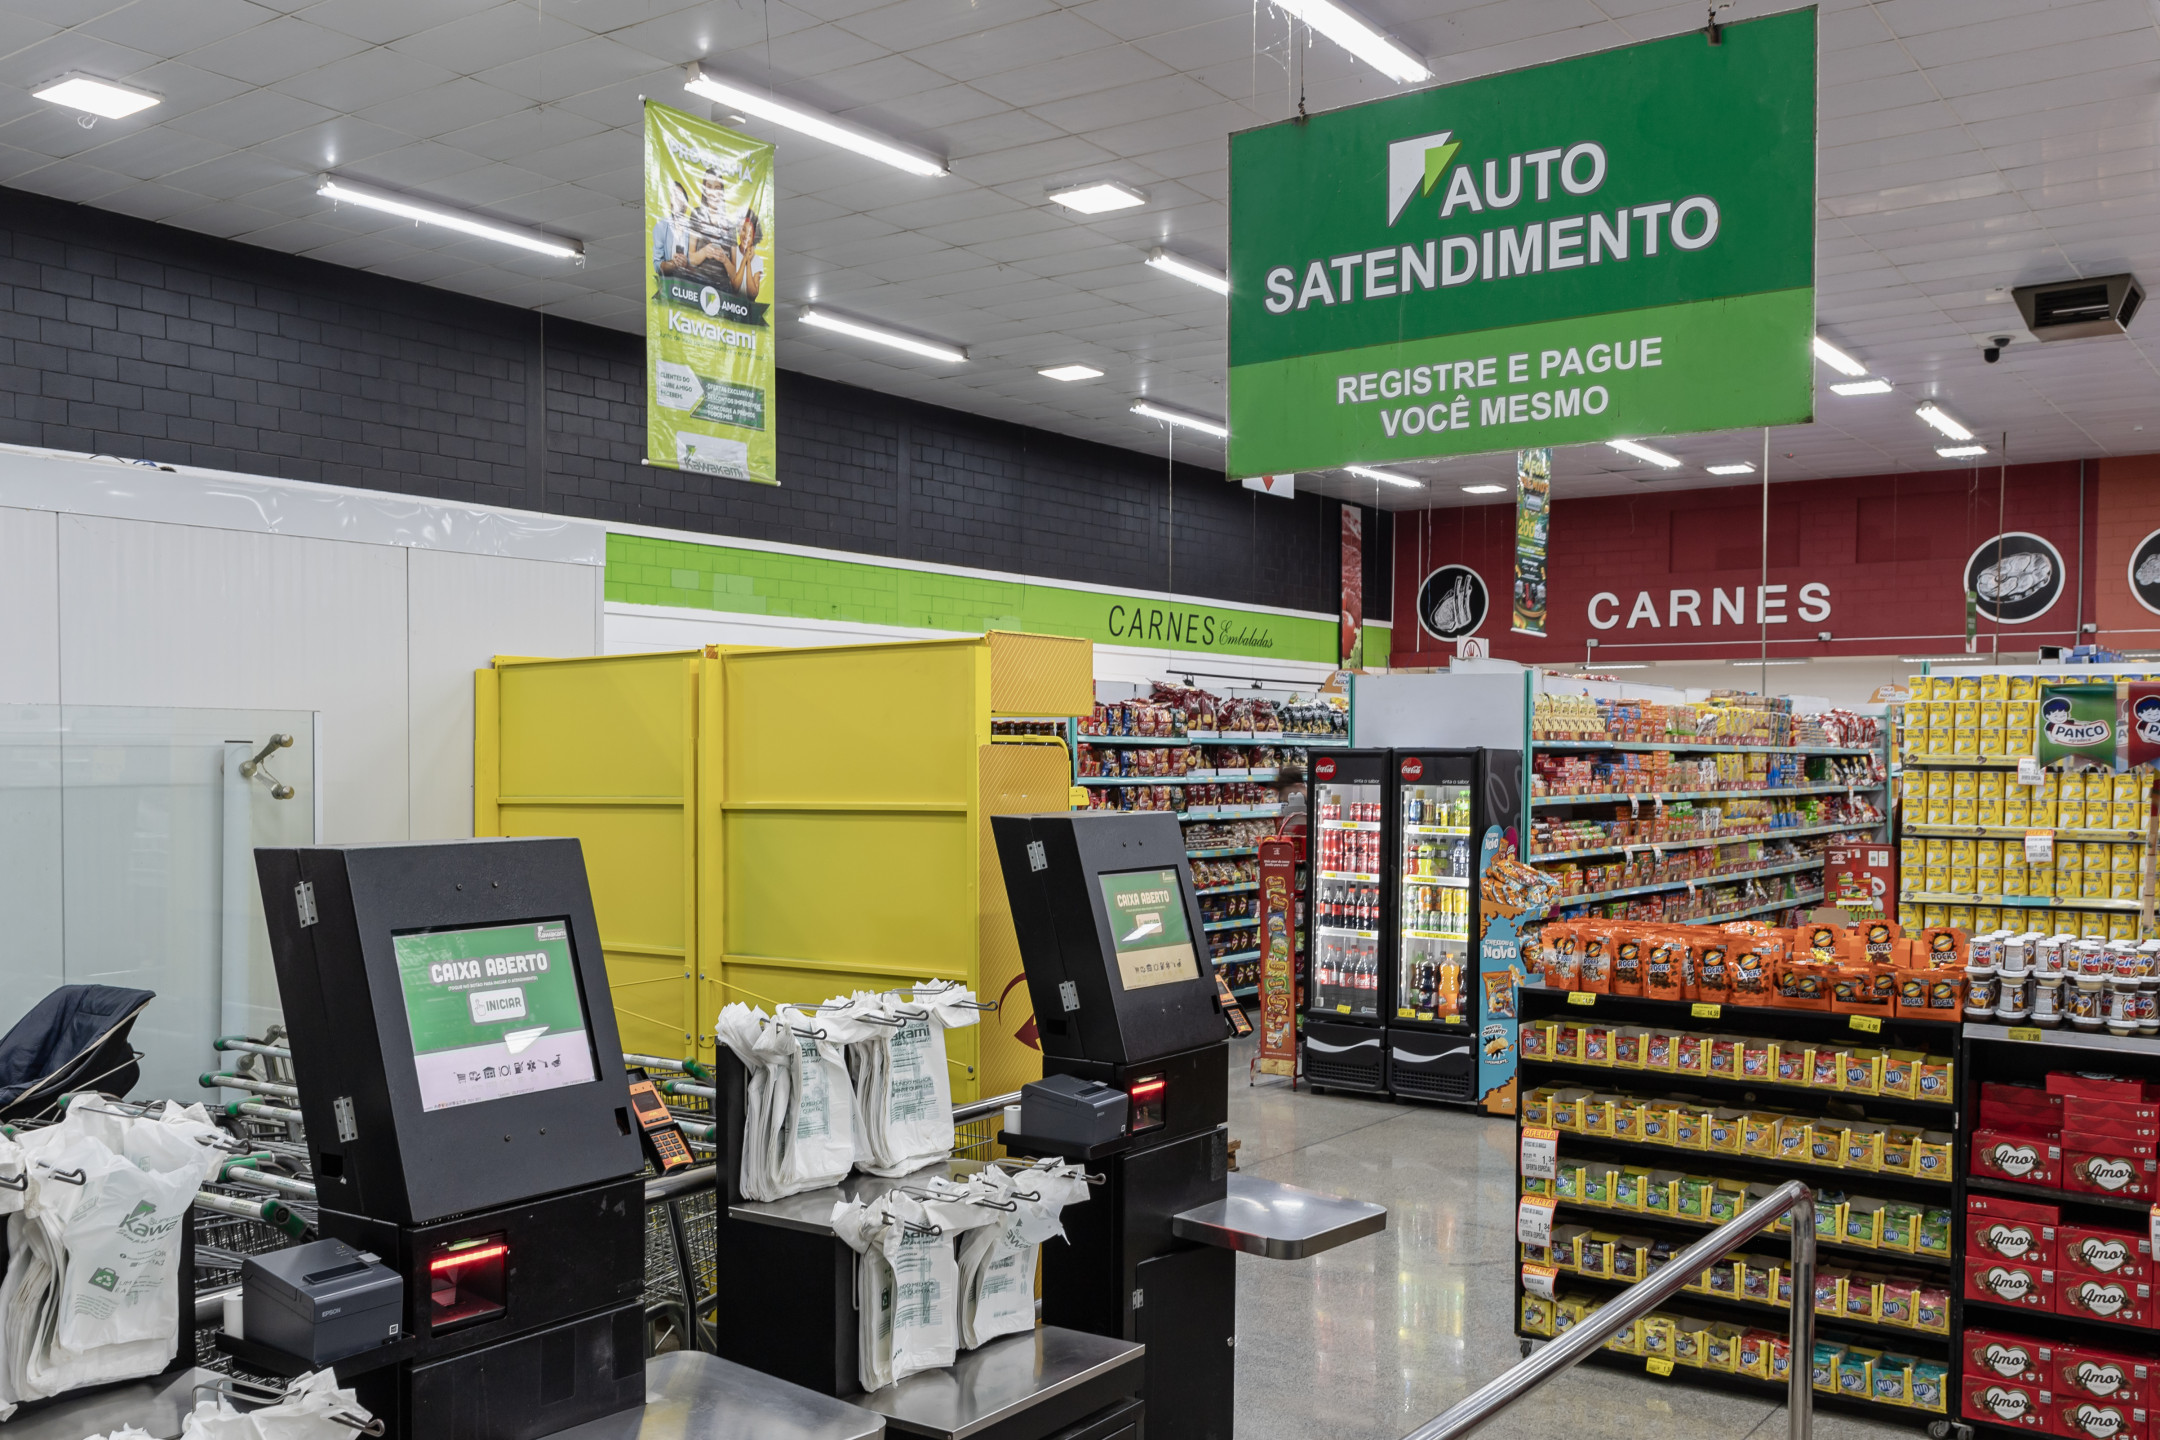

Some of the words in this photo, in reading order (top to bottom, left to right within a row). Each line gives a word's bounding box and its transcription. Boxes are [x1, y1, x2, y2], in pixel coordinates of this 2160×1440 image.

[1440, 142, 1607, 218] AUTO
[1264, 197, 1719, 313] SATENDIMENTO
[672, 286, 698, 302] CLUBE
[722, 301, 748, 316] AMIGO
[668, 309, 756, 350] Kawakami
[1338, 357, 1497, 403] REGISTRE
[1509, 354, 1529, 383] E
[1541, 337, 1662, 378] PAGUE
[1381, 395, 1471, 437] VOCÊ
[1481, 386, 1609, 427] MESMO
[1518, 518, 1536, 537] 200
[1587, 582, 1831, 630] CARNES
[1109, 605, 1215, 645] CARNES
[1219, 620, 1274, 648] Embaladas
[2055, 725, 2104, 738] PANCO
[1117, 893, 1140, 907] CAIXA
[1140, 890, 1170, 904] ABERTO
[1482, 945, 1517, 960] NOVO
[1866, 943, 1892, 953] ROCKS
[1617, 960, 1639, 968] ROCKS
[1930, 951, 1957, 962] ROCKS
[431, 960, 481, 983] CAIXA
[485, 952, 548, 976] ABERTO
[486, 997, 521, 1011] INICIAR
[1848, 1070, 1864, 1080] MID
[1885, 1072, 1901, 1082] MID
[1921, 1078, 1937, 1088] MID
[1524, 1129, 1556, 1140] OFERTA
[1646, 1124, 1660, 1133] MID
[1712, 1130, 1726, 1140] MID
[1921, 1156, 1937, 1166] MID
[1993, 1149, 2040, 1166] Amor
[2087, 1163, 2133, 1179] Amor
[1522, 1196, 1554, 1208] OFERTA
[1987, 1231, 2033, 1246] Amor
[2081, 1244, 2127, 1260] Amor
[1986, 1273, 2032, 1289] Amor
[2080, 1288, 2126, 1304] Amor
[321, 1306, 341, 1318] EPSON
[1884, 1302, 1899, 1313] MID
[1920, 1310, 1934, 1320] MID
[1742, 1351, 1757, 1362] MID
[1985, 1350, 2030, 1366] Amor
[2077, 1368, 2124, 1385] Amor
[1877, 1380, 1892, 1390] MID
[1913, 1384, 1929, 1395] MID
[1985, 1393, 2030, 1409] Amor
[2076, 1411, 2123, 1427] Amor
